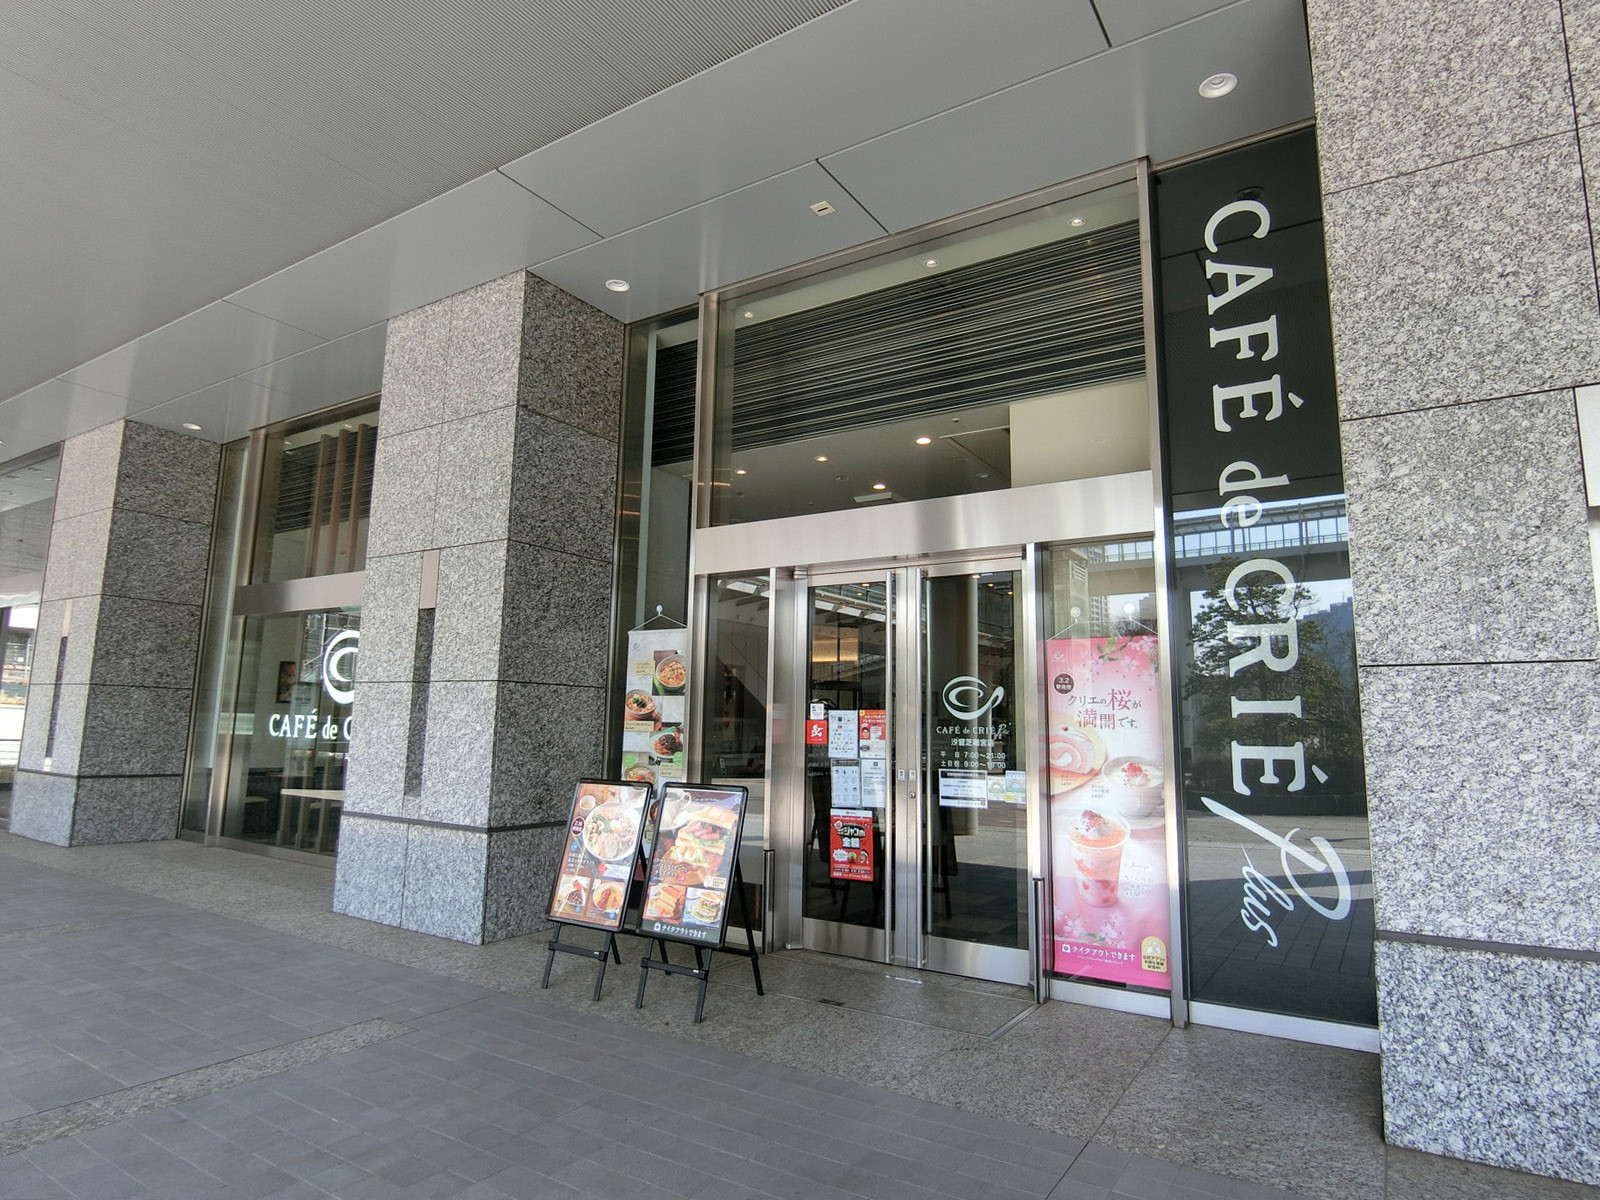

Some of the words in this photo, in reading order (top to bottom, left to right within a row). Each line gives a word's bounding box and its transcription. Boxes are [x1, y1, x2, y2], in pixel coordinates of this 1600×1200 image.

[1204, 199, 1305, 433] CAFÉ
[1218, 460, 1291, 529] de
[1224, 558, 1329, 797] CRIÉ
[1067, 688, 1142, 711] クリエの桜が
[268, 708, 319, 739] CAFÉ
[322, 714, 338, 740] de
[936, 724, 961, 735] CAFÉ
[962, 726, 971, 735] de
[972, 725, 996, 735] CRIÉ
[1076, 708, 1138, 730] 満開です。
[1200, 796, 1352, 948] Plus
[661, 924, 707, 939] テイクアウトできます
[1071, 945, 1136, 962] テイクアウトできます
